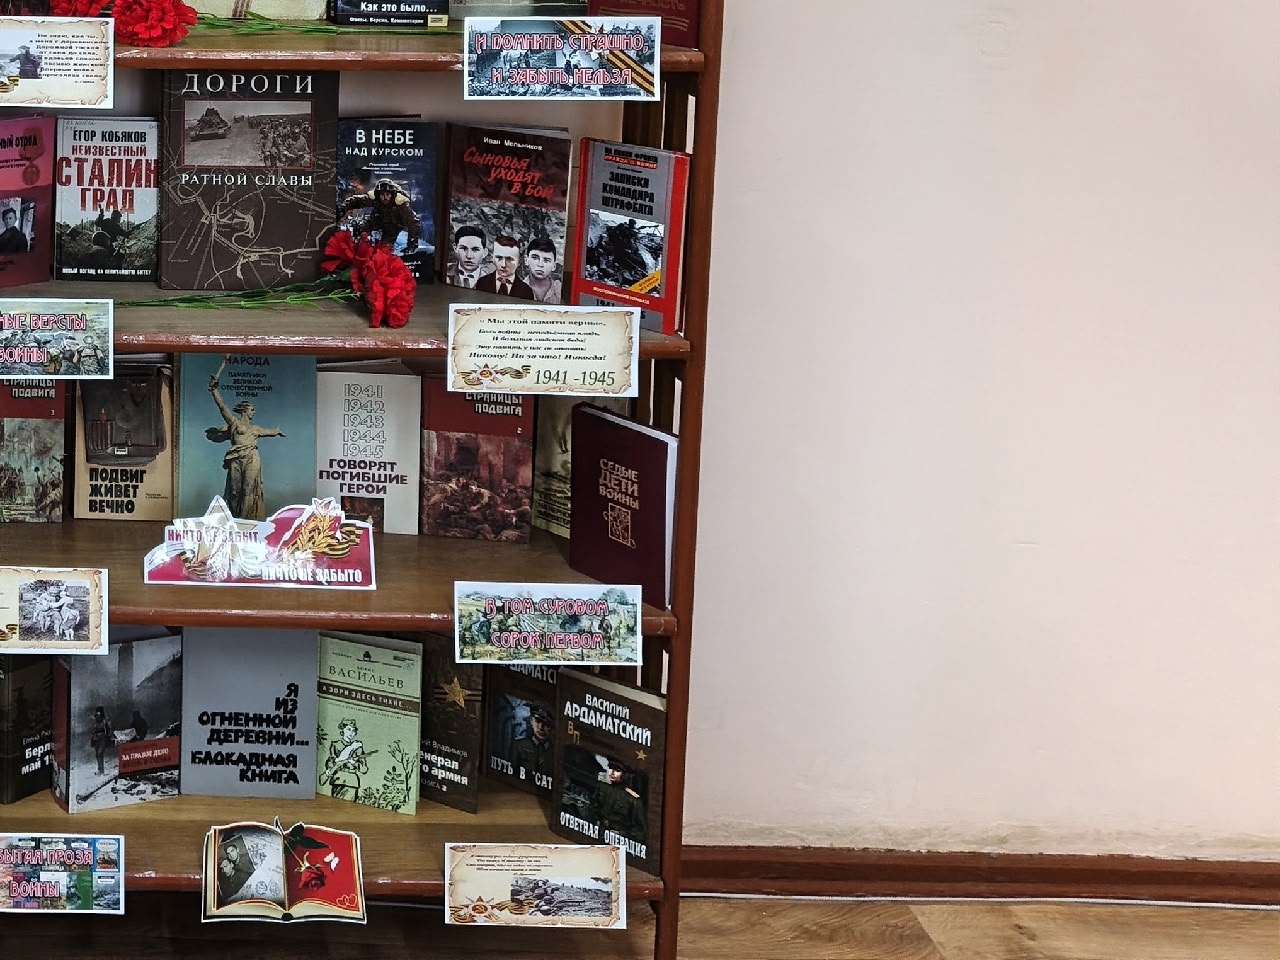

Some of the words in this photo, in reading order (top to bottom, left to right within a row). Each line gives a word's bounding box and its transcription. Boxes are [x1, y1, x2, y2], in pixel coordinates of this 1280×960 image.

[360, 2, 378, 12] Как
[381, 3, 398, 12] это
[400, 2, 437, 13] было...
[476, 32, 488, 54] И
[492, 32, 564, 50] ПОМНИТЬ
[569, 32, 649, 53] СТРАШНО,
[182, 74, 313, 95] ДОРОГИ
[492, 69, 502, 84] И
[508, 68, 568, 85] ЗАБЫТЬ
[573, 68, 632, 86] НЕЛЬЗЯ
[73, 130, 97, 142] ЕГОР
[101, 130, 147, 143] КОБЯКОВ
[356, 130, 366, 143] В
[371, 130, 414, 144] НЕБЕ
[72, 143, 147, 157] НЕИЗВЕСТНЫЙ
[346, 147, 367, 157] НАД
[371, 147, 424, 157] КУРСКОМ
[57, 156, 159, 188] СТАЛИН
[182, 172, 247, 186] РАТНОЙ
[255, 175, 313, 187] СЛАВЫ
[80, 187, 135, 214] ГРАД
[30, 314, 87, 329] ВЕРСТЫ
[225, 356, 270, 366] НАРОДА
[534, 369, 570, 386] 1941
[12, 387, 55, 399] ПОДВИГА
[344, 384, 383, 398] 1941
[344, 400, 385, 413] 1942
[475, 403, 522, 416] ПОДВИГА
[343, 414, 384, 428] 1943
[342, 430, 386, 443] 1944
[342, 444, 384, 458] 1945
[329, 459, 397, 472] ГОВОРЯТ
[599, 459, 639, 481] СЕДЫЕ
[89, 468, 147, 485] ПОДВИГ
[319, 470, 408, 485] ПОГИБШИЕ
[599, 471, 639, 497] ДЕТИ
[89, 484, 139, 499] ЖИВЕТ
[339, 484, 387, 495] ГЕРОИ
[599, 485, 640, 510] ВОЙНЫ
[88, 499, 135, 514] ВЕЧНО
[486, 598, 496, 618] В
[501, 598, 535, 614] ТОМ
[539, 599, 609, 615] СУРОВОМ
[491, 632, 541, 648] СОРОК
[546, 633, 605, 649] ПЕРВОМ
[329, 666, 404, 688] ВАСИЛЬЕВ
[286, 683, 299, 698] Я
[329, 687, 349, 695] ЗОРИ
[351, 692, 376, 700] ЗДЕСЬ
[275, 697, 298, 712] ИЗ
[585, 693, 631, 720] ВАСИЛИЙ
[198, 711, 297, 730] ОГНЕННОЙ
[564, 700, 652, 747] АРДАМАТСКИЙ
[207, 729, 310, 747] ДЕРЕВНИ...
[190, 751, 298, 768] БЛОКАДНАЯ
[239, 768, 299, 785] КНИГА
[560, 811, 600, 839] ОТВЕТНАЯ
[604, 829, 647, 860] ОПЕРАЦИЯ
[47, 849, 93, 865] ПРОЗА
[9, 879, 60, 897] ВОЙНЫ
